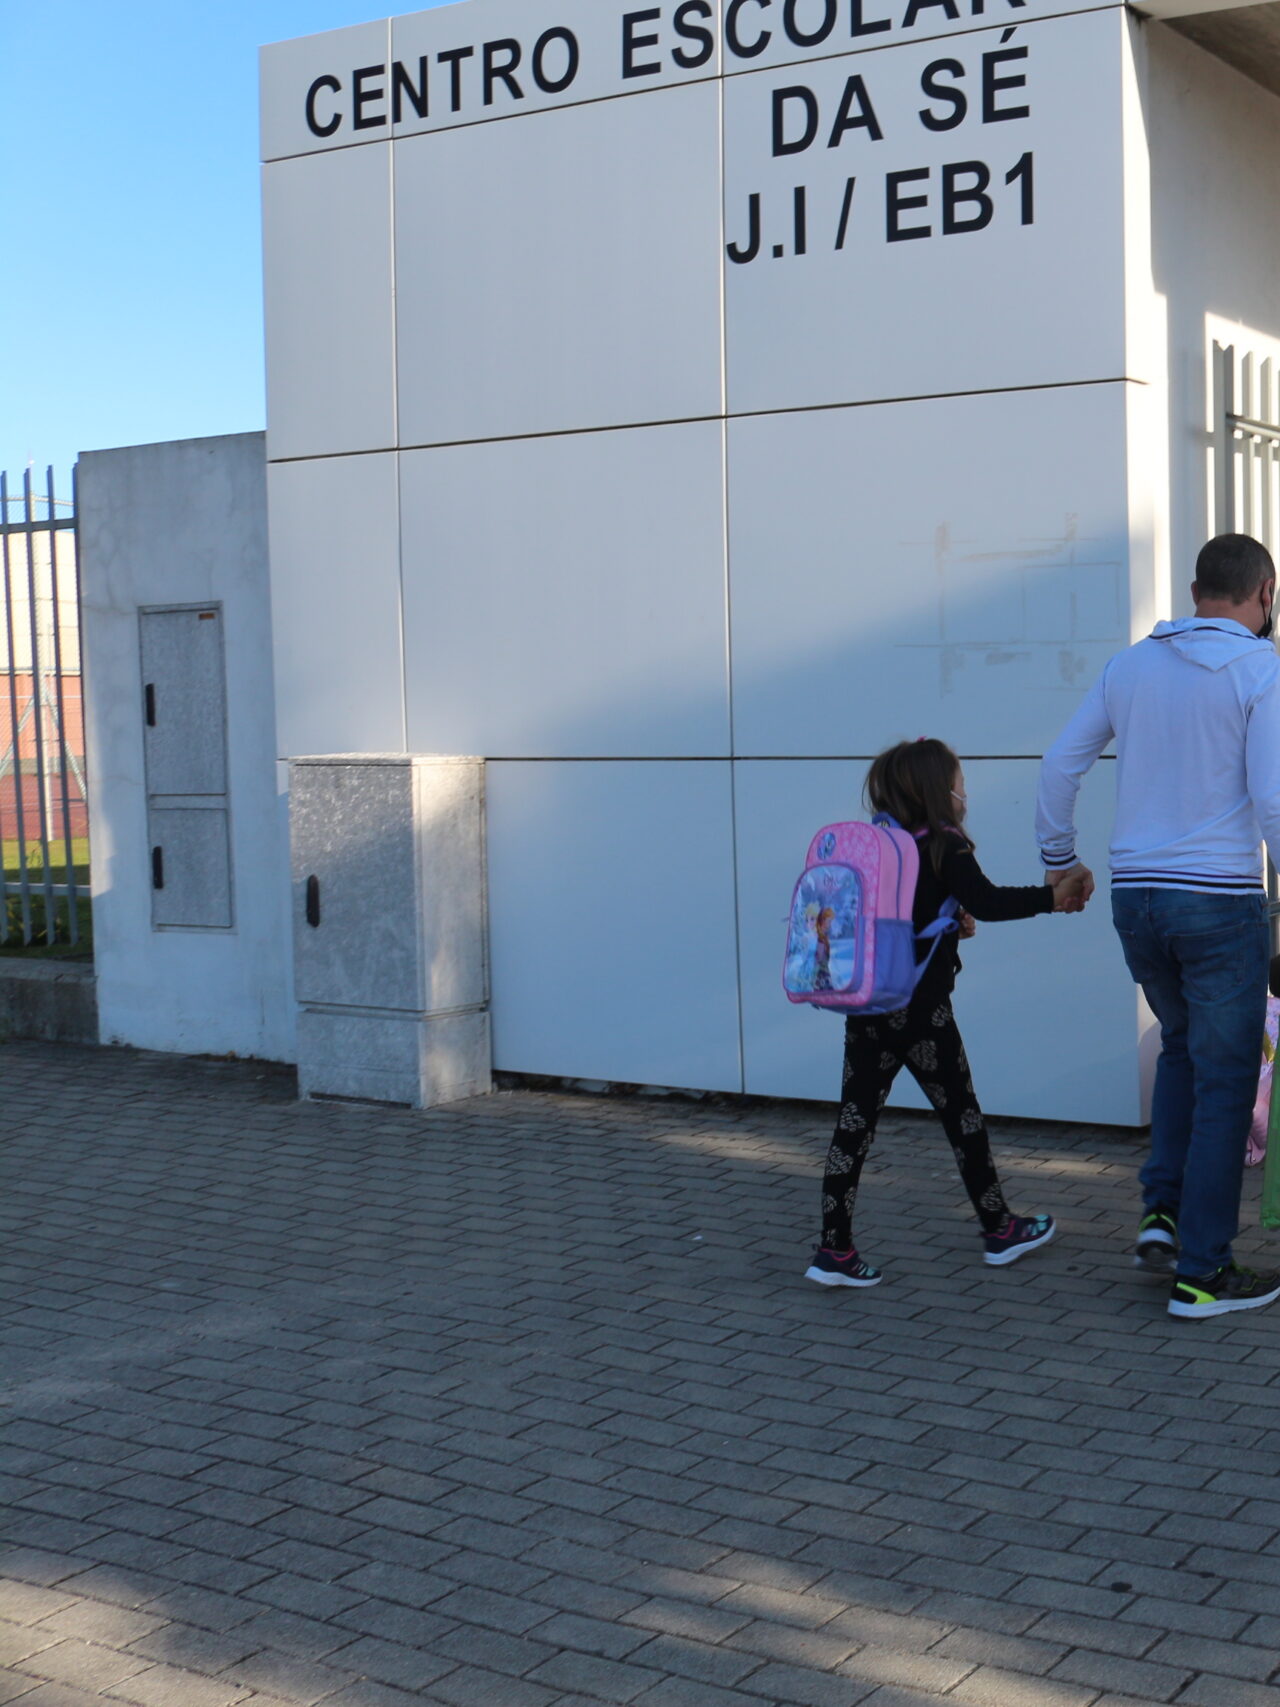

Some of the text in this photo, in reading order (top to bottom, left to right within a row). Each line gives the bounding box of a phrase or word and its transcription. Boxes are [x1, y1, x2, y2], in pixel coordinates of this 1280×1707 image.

[305, 0, 1027, 138] CENTRO ESCOL
[772, 27, 1030, 157] DA SÉ
[726, 152, 1033, 264] J.I / EB1
